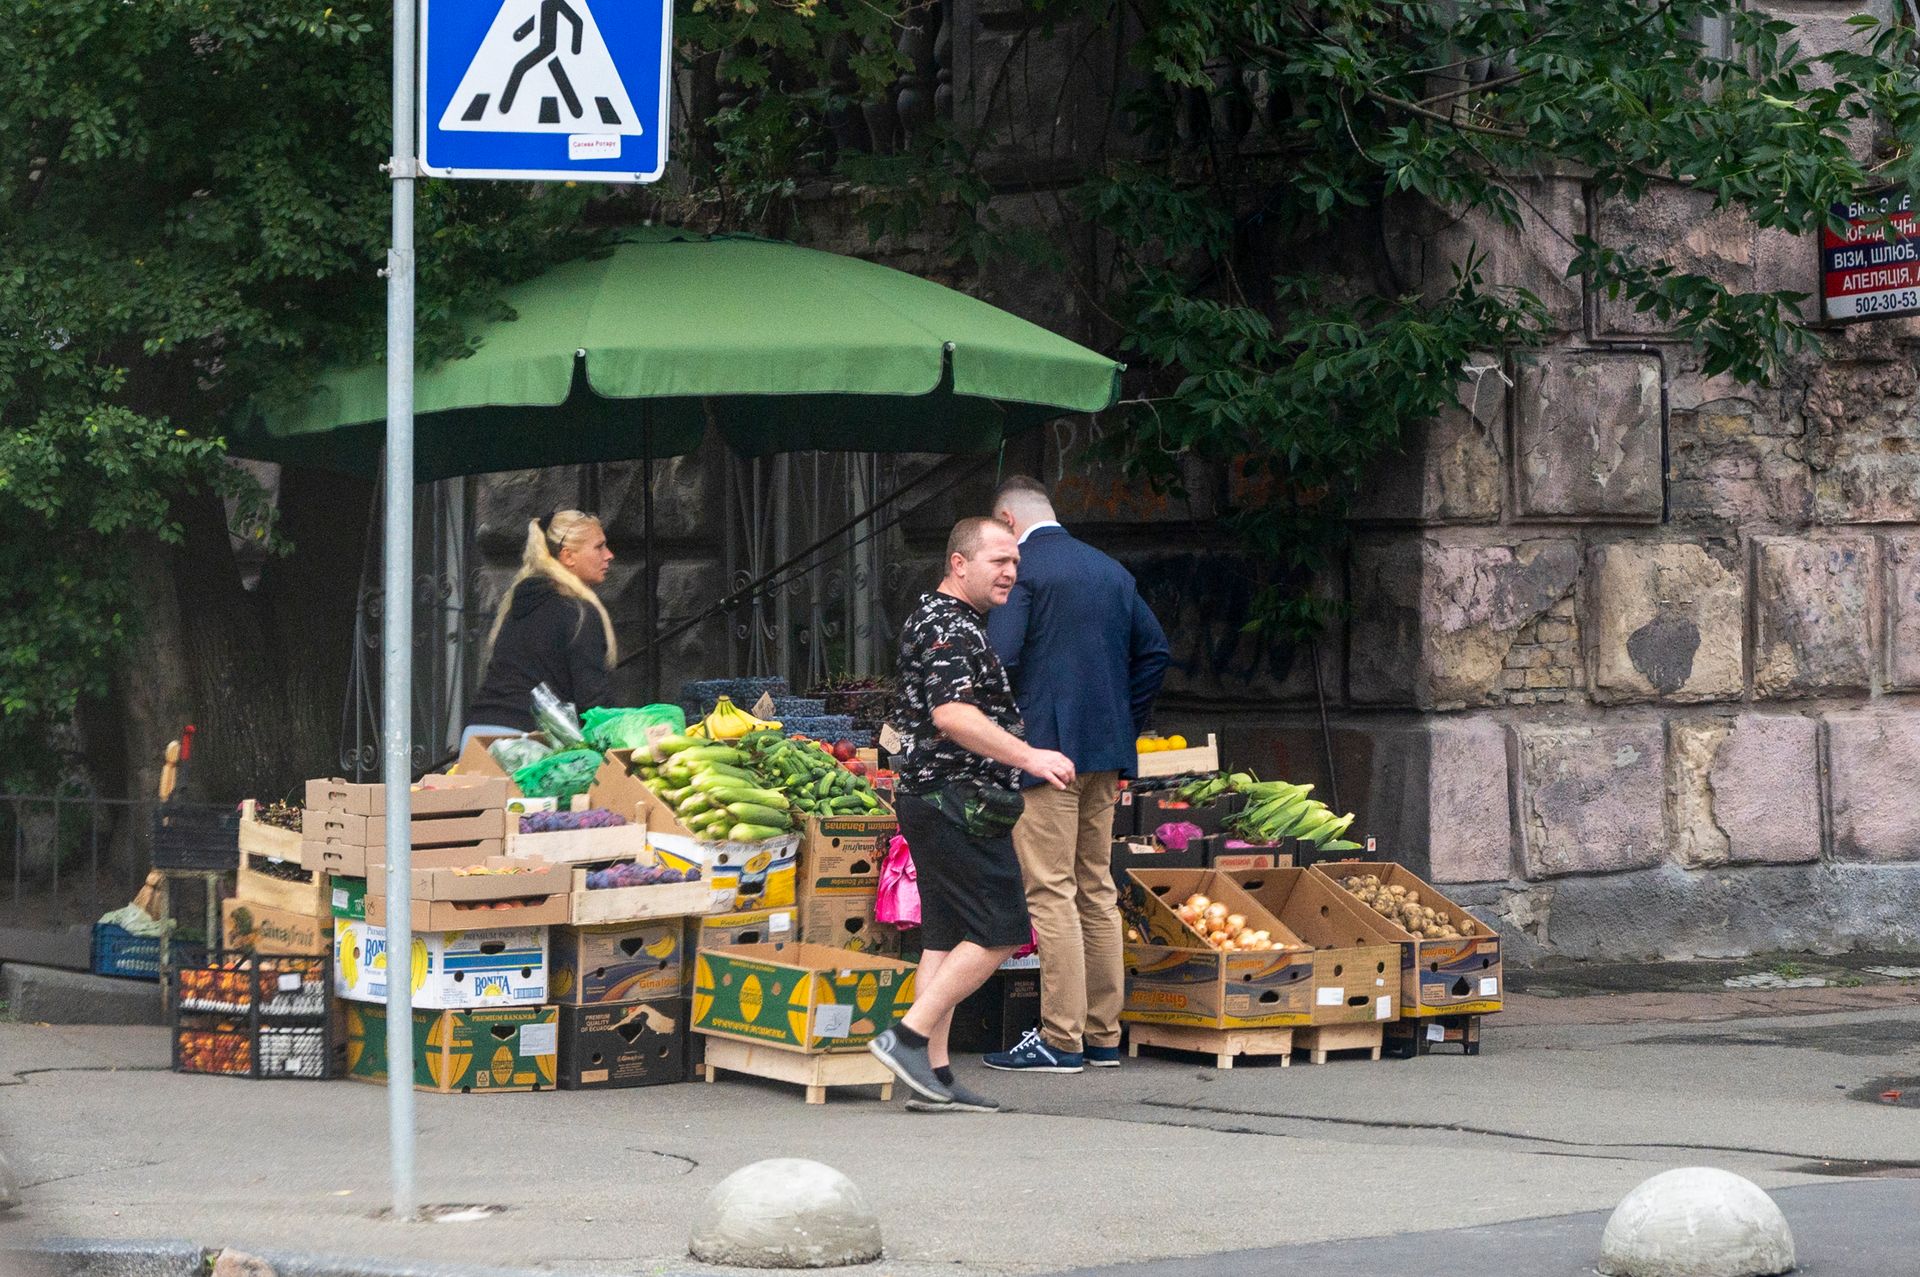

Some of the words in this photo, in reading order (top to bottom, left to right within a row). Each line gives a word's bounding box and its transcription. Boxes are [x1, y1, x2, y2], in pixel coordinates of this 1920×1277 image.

[1834, 250, 1868, 269] ВІЗИ,
[1871, 243, 1918, 264] ШЛЮБ,
[1843, 267, 1913, 291] АПЕЛЯЦІЯ,
[1855, 291, 1917, 313] 502-30-53
[825, 822, 865, 832] Bananas
[842, 842, 875, 853] Ginafruit
[475, 975, 511, 996] BONITA
